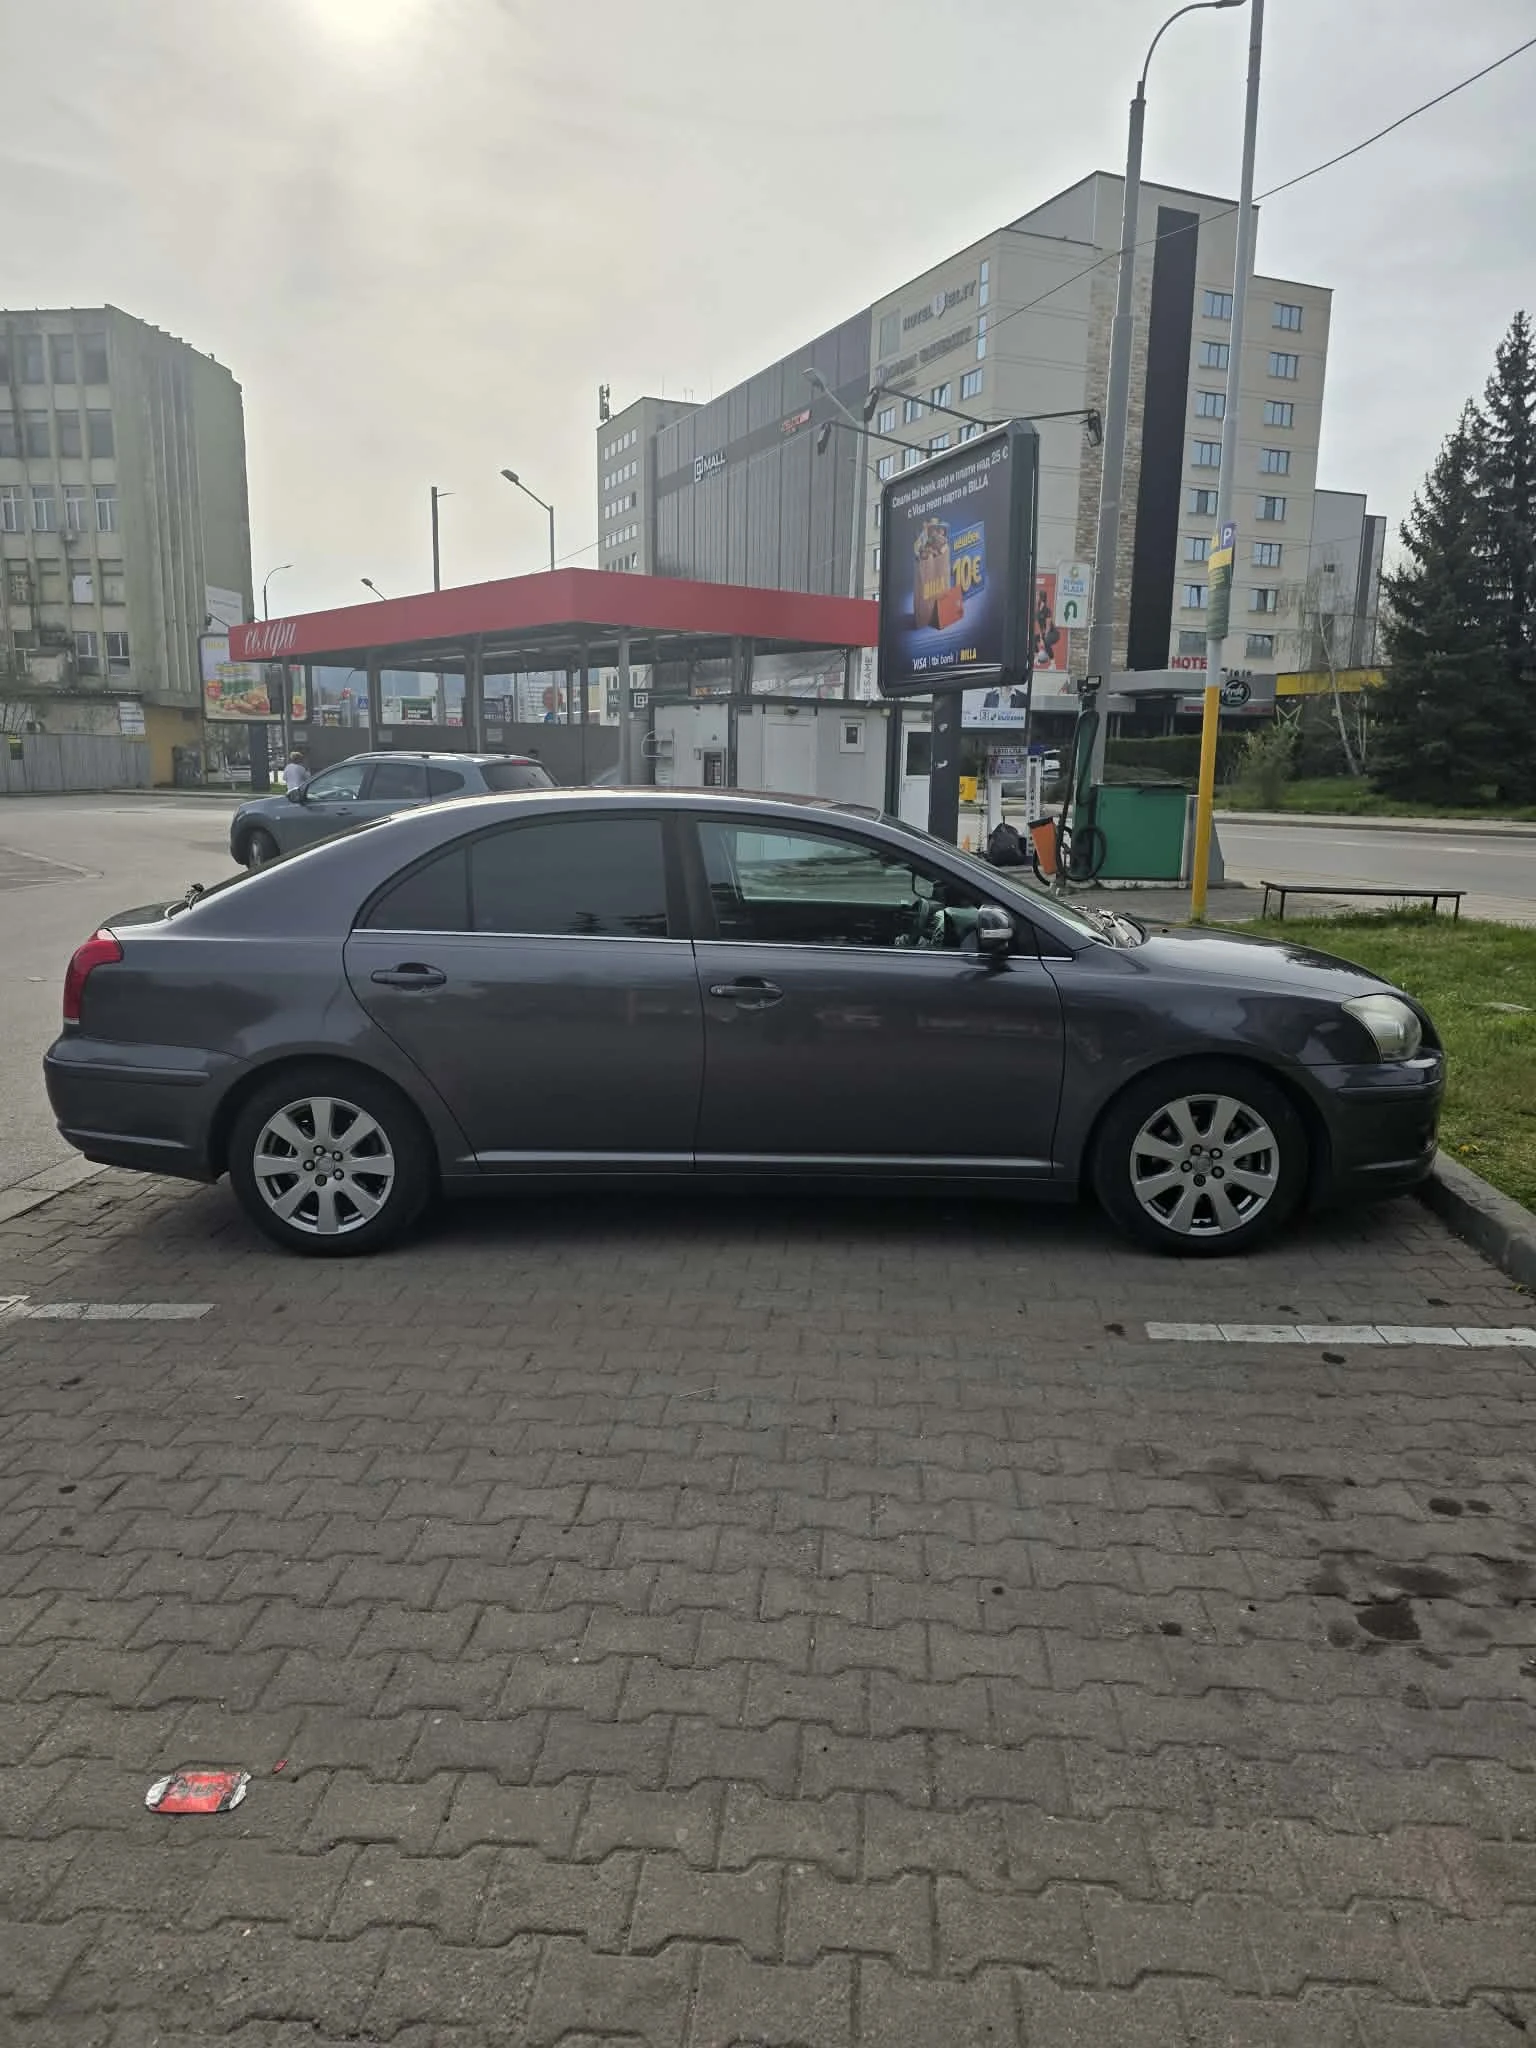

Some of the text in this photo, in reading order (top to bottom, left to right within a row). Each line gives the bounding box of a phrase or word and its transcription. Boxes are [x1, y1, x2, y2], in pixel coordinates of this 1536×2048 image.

[991, 449, 1001, 465] 25
[912, 501, 925, 517] Visa
[968, 474, 989, 493] BILLA
[1223, 527, 1232, 546] P
[913, 657, 927, 671] VISA
[960, 648, 977, 661] BILLA
[1171, 655, 1208, 670] HOTE
